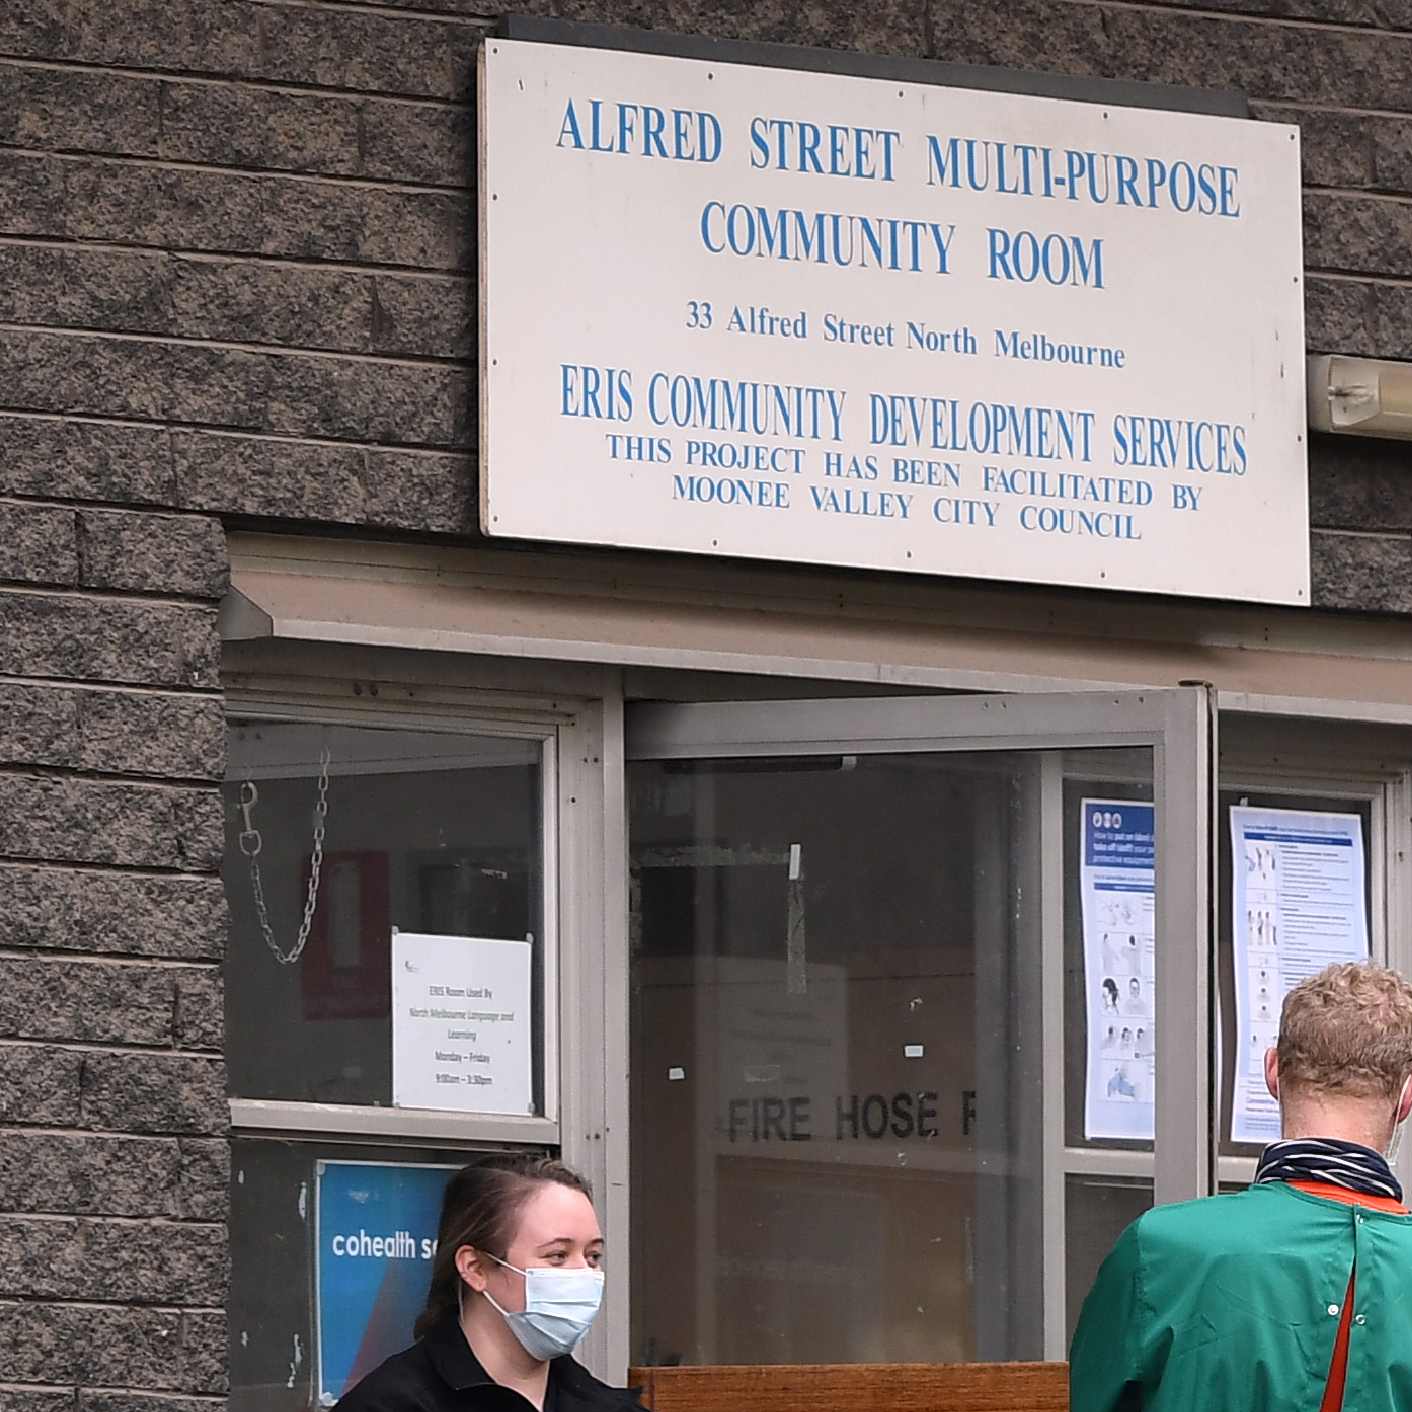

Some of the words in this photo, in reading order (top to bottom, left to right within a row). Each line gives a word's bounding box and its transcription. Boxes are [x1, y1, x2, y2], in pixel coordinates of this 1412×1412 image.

[556, 98, 721, 162] ALFRED
[751, 117, 900, 182] STREET
[926, 135, 1240, 217] MULTI-PURPOSE
[701, 202, 956, 274] COMMUNITY
[986, 228, 1104, 289] ROOM
[686, 301, 712, 328] 33
[726, 306, 806, 338] Alfred
[824, 314, 894, 347] Street
[907, 322, 977, 354] North
[995, 330, 1125, 368] Melbourne
[560, 365, 632, 422] ERIS
[649, 373, 846, 441] COMMUNITY
[870, 394, 1095, 462] DEVELOPMENT
[1114, 415, 1246, 475] SERVICES
[606, 434, 671, 463] THIS
[687, 440, 805, 473] PROJECT
[825, 452, 877, 480] HAS
[893, 459, 960, 486] BEEN
[984, 467, 1152, 505] FACILITATED
[1173, 484, 1203, 510] BY
[673, 475, 789, 508] MOONEE
[810, 486, 913, 518] VALLEY
[934, 498, 1000, 526] CITY
[1020, 506, 1141, 539] COUNCIL
[728, 1096, 812, 1143] FIRE
[836, 1091, 939, 1141] HOSE
[332, 1228, 416, 1258] cohealth
